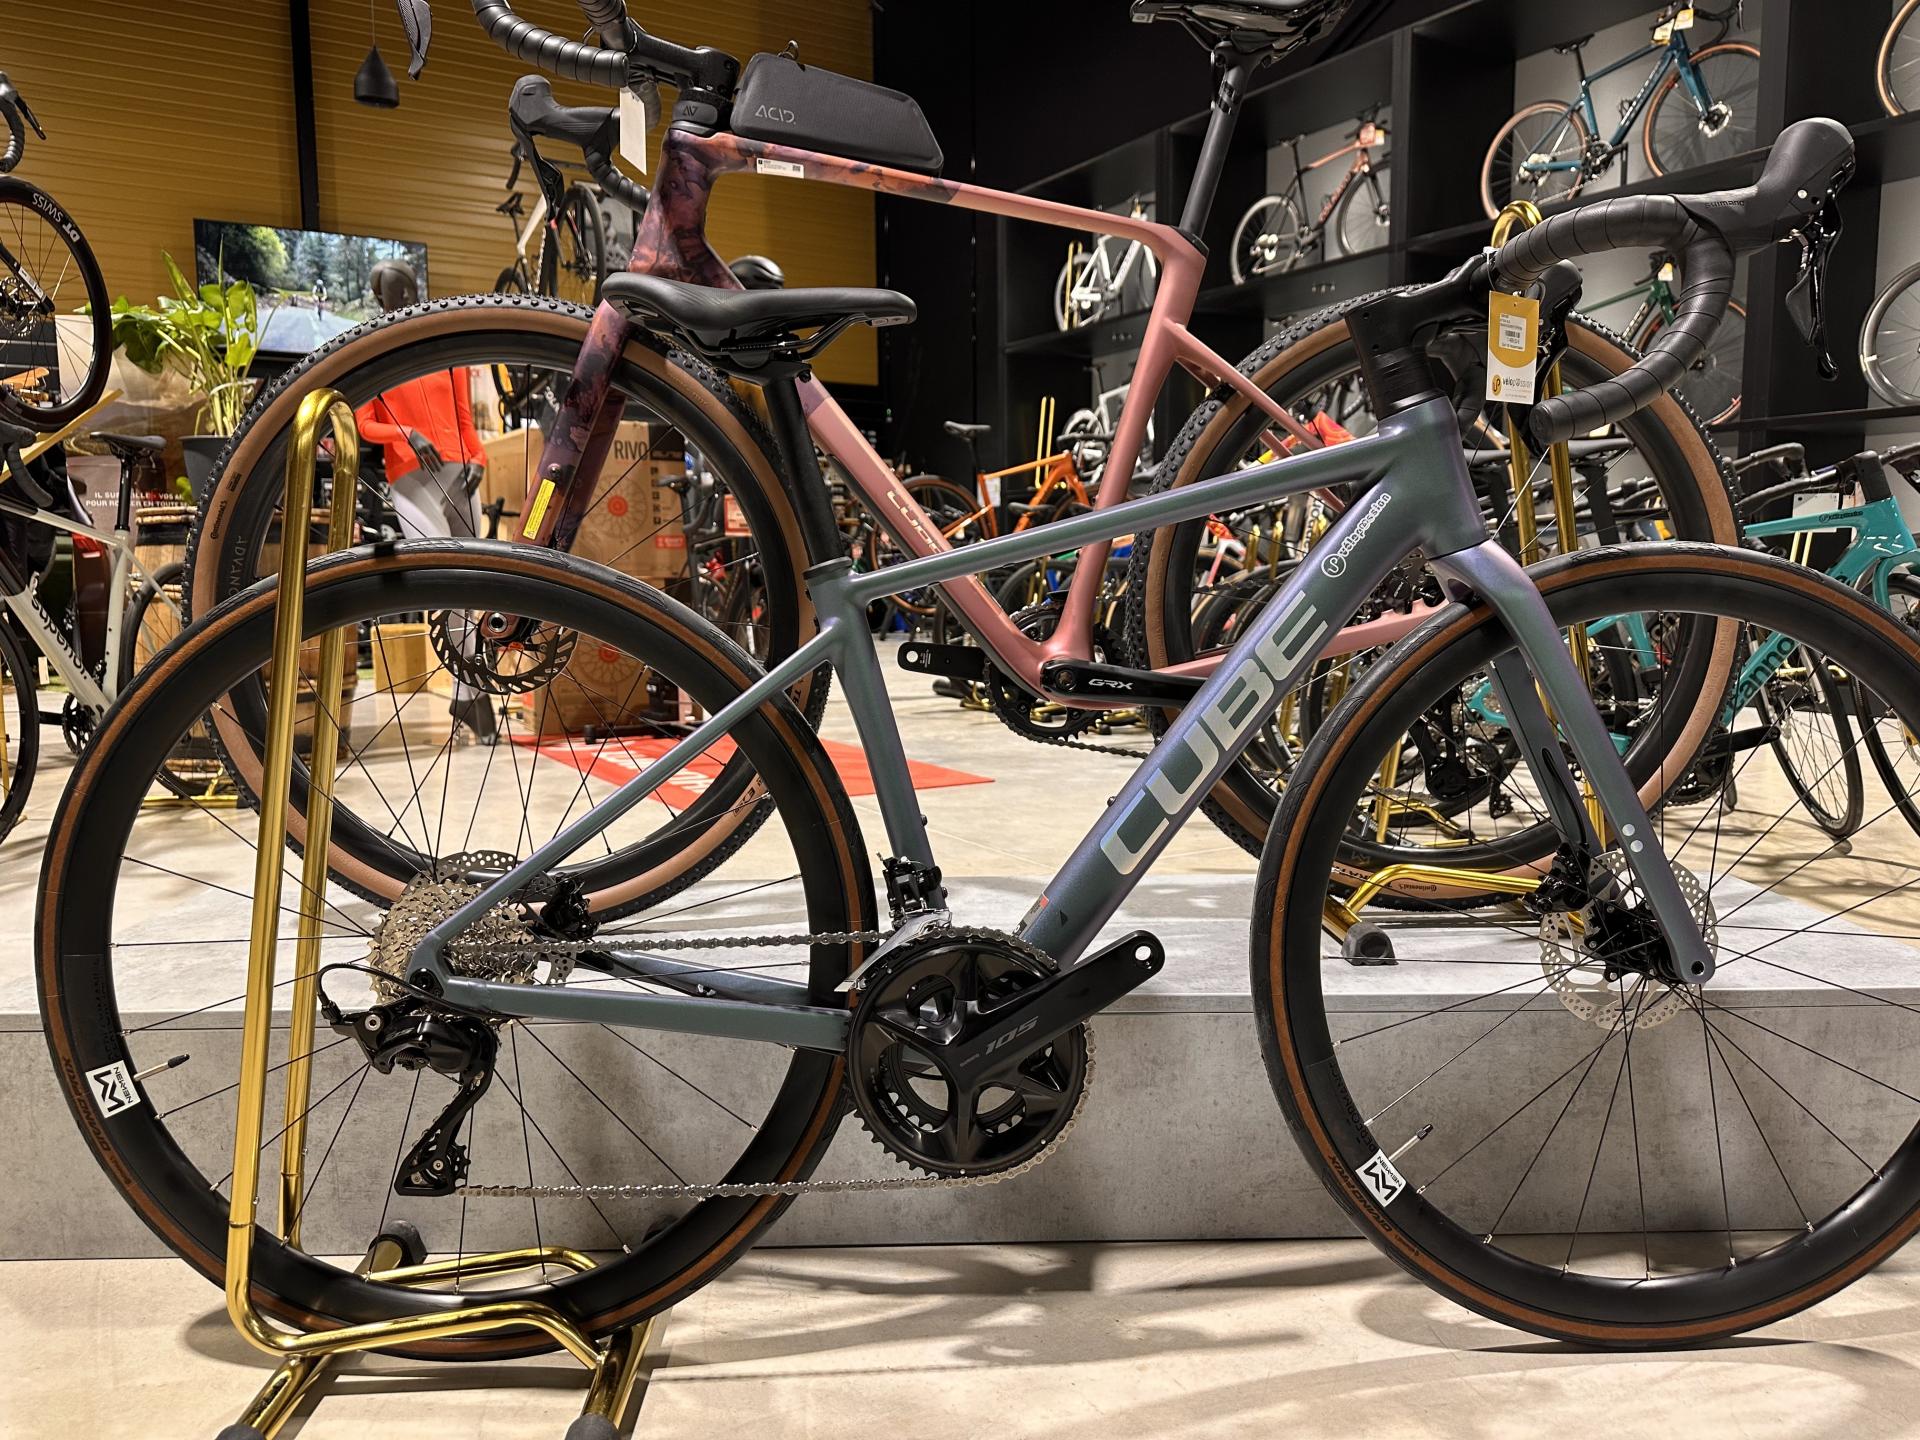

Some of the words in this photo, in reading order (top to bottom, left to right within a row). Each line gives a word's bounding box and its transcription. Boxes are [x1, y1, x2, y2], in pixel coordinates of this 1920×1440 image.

[32, 193, 64, 222] SWISS
[62, 222, 80, 242] DT
[1088, 678, 1134, 690] GRX
[1100, 589, 1328, 876] CUBE
[985, 1015, 1039, 1055] 105
